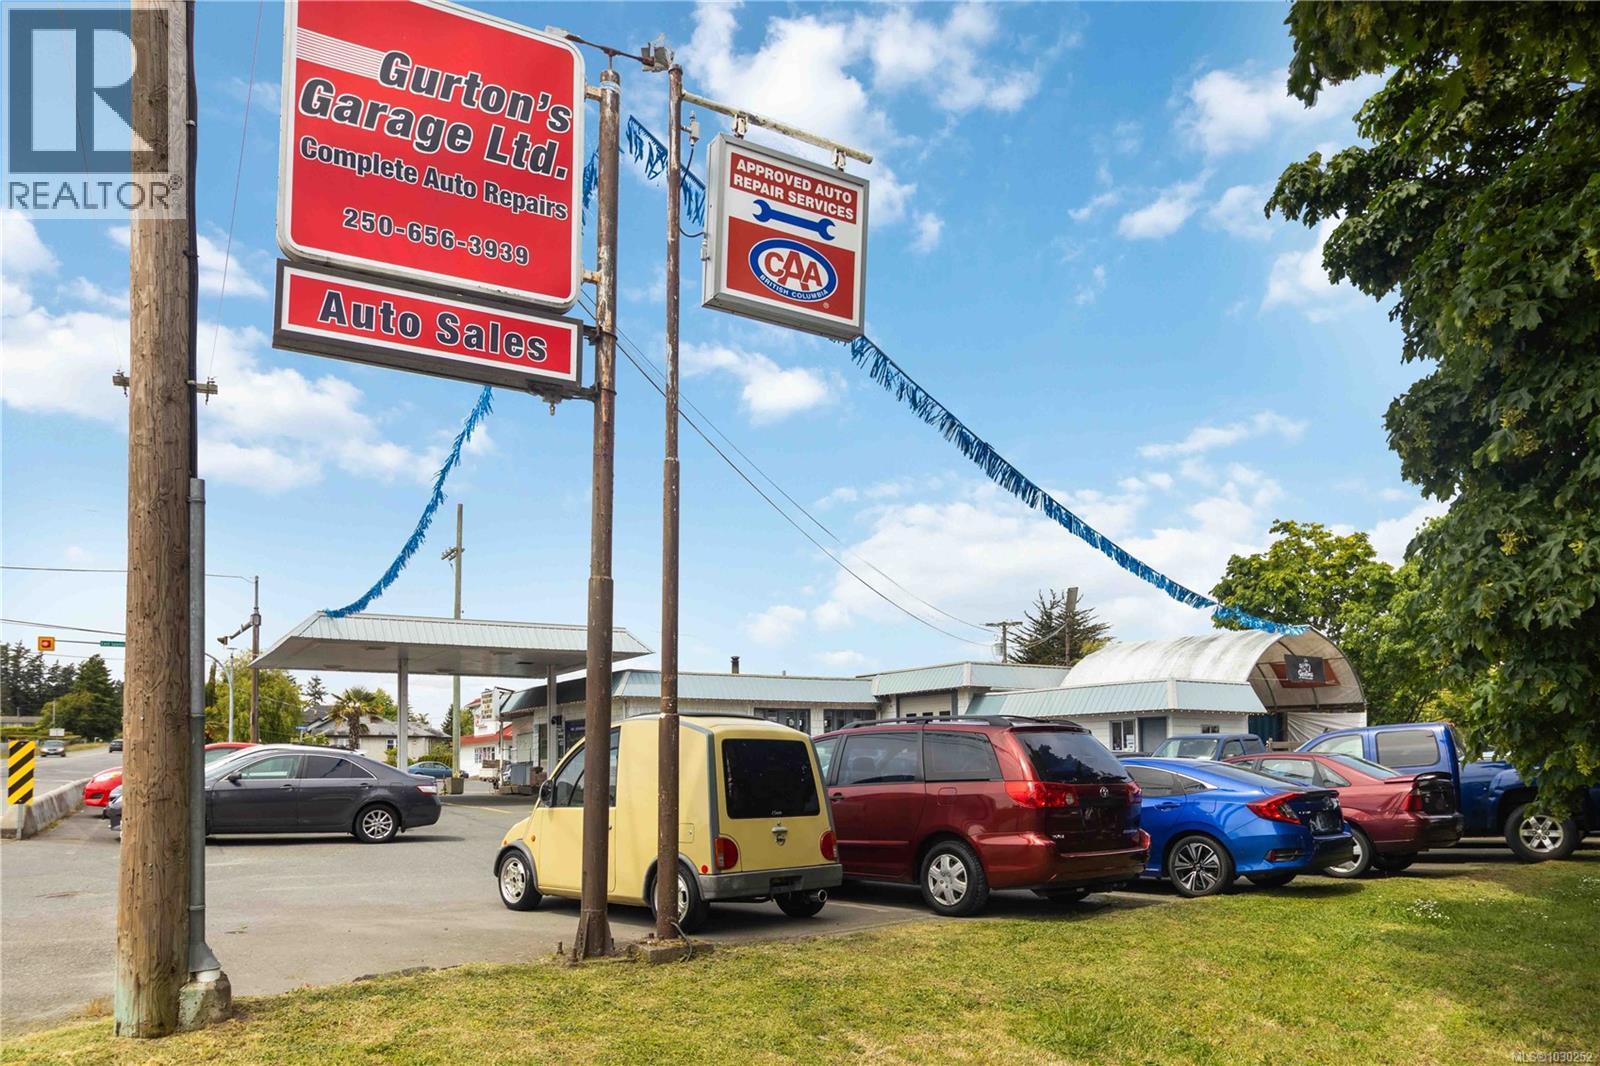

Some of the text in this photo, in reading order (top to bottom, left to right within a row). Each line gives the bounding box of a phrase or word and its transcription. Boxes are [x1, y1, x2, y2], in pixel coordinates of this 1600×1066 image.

[378, 50, 573, 134] Gurton's
[299, 77, 568, 180] Garage Ltd.
[299, 136, 568, 221] Complete Auto Repairs
[733, 174, 854, 220] REPAIR SERVICES
[736, 158, 852, 204] APPROVED AUTO
[342, 207, 530, 267] 250-656-3939
[759, 274, 829, 301] BRITISH COLUMBIA
[764, 249, 823, 292] CAA
[317, 290, 549, 363] Auto Sales
